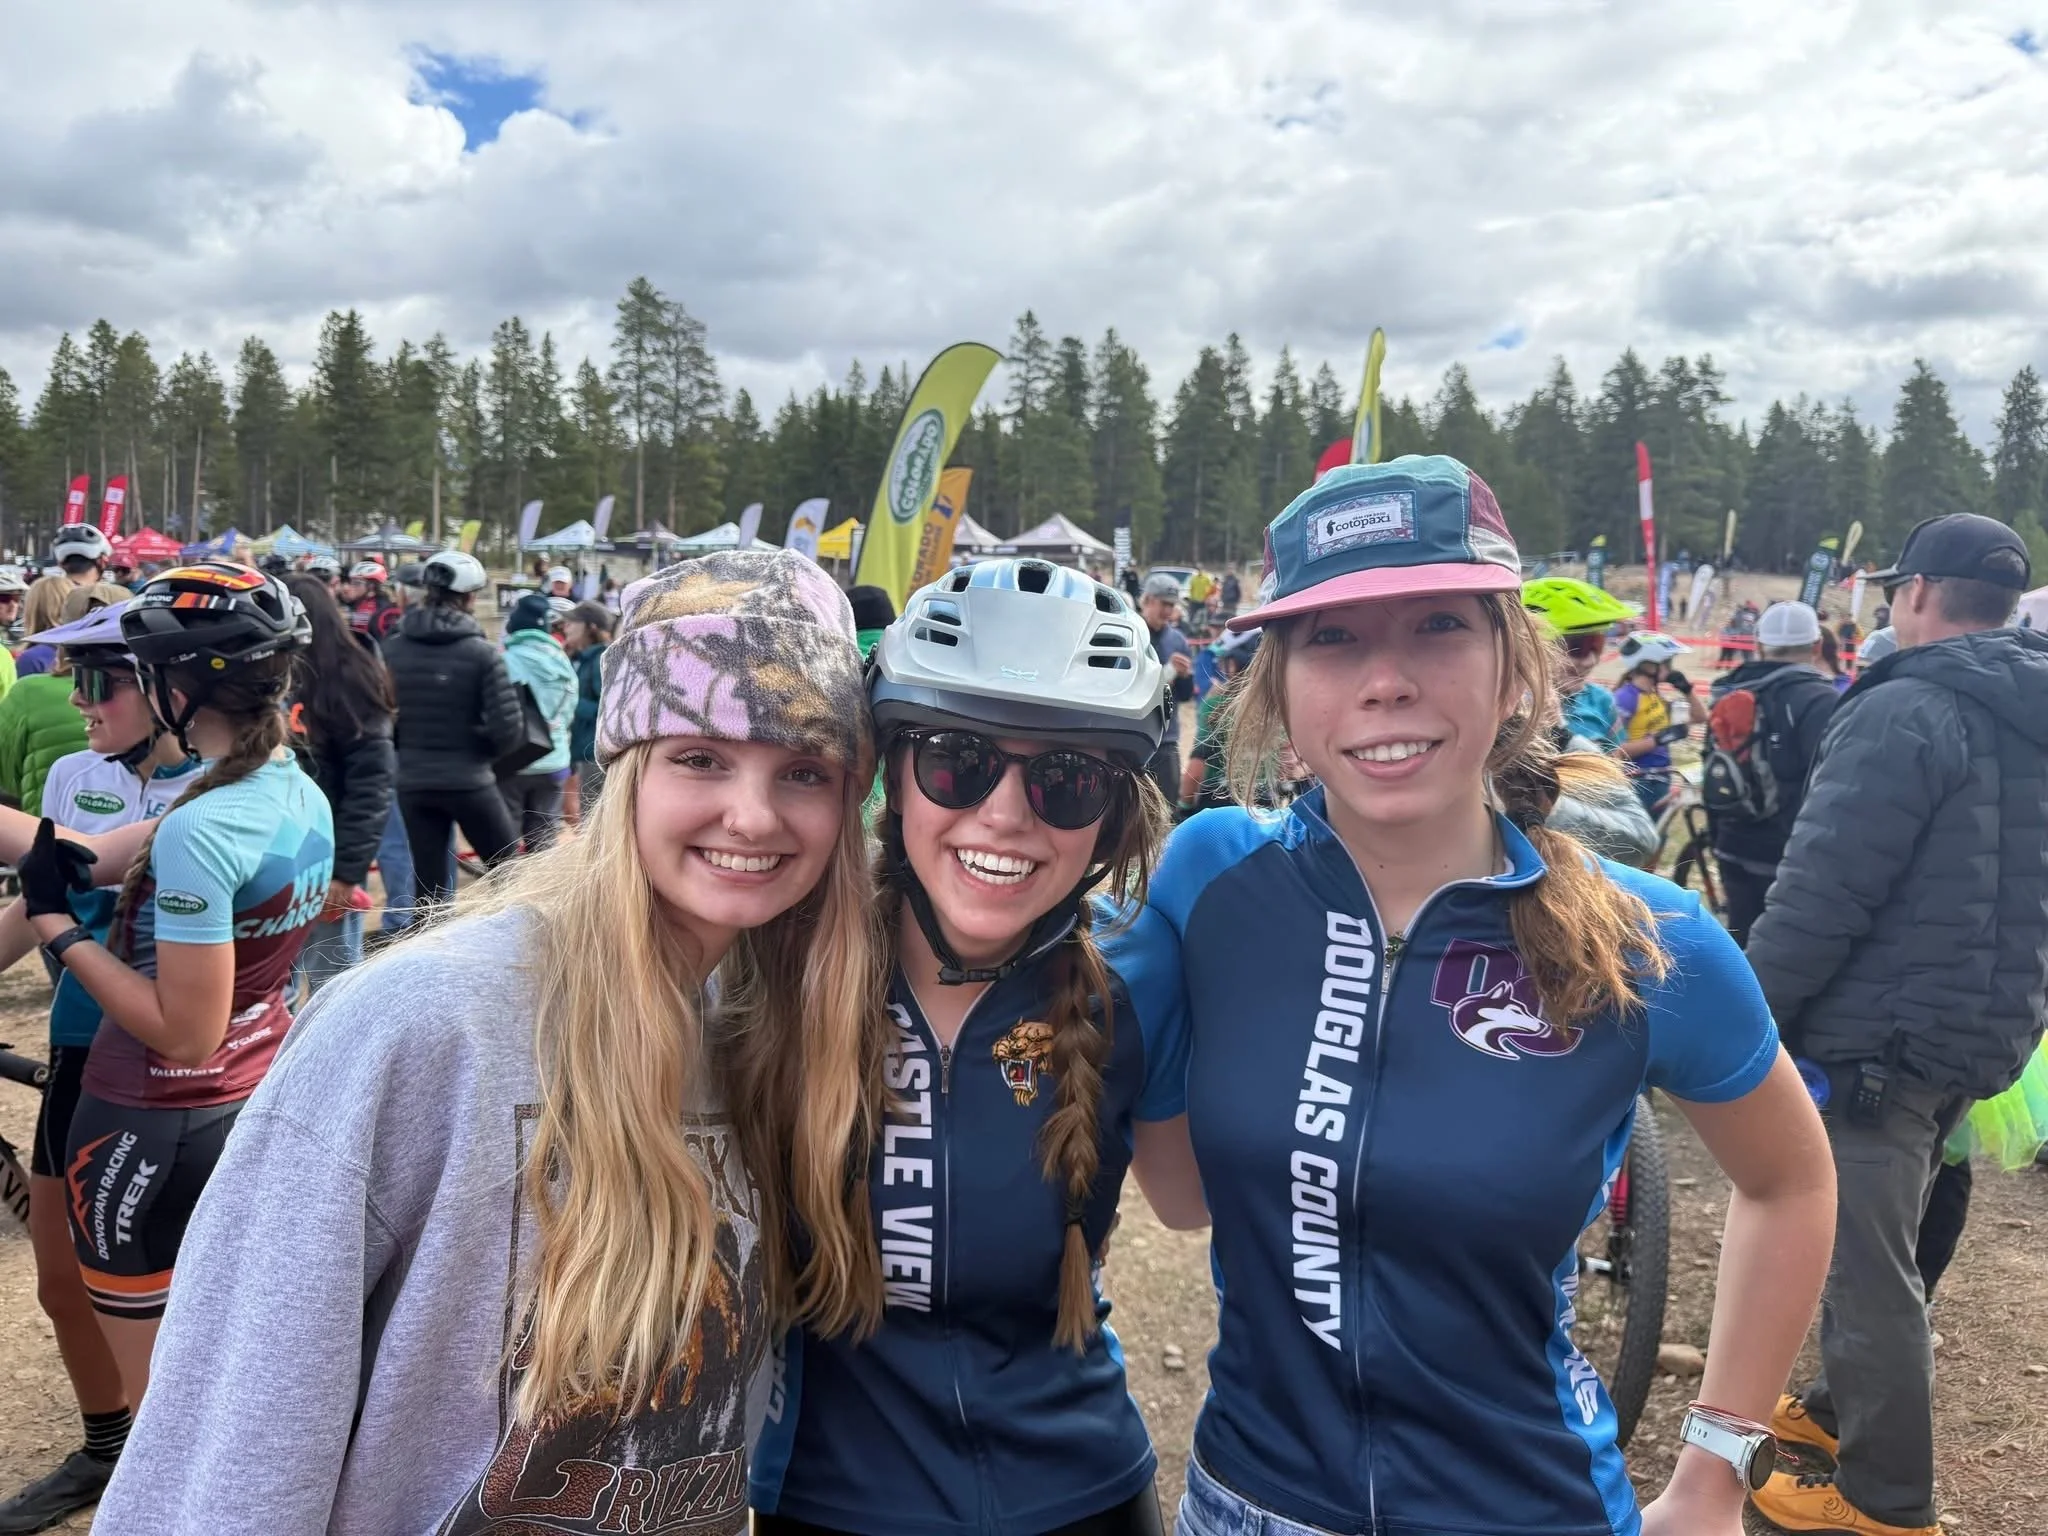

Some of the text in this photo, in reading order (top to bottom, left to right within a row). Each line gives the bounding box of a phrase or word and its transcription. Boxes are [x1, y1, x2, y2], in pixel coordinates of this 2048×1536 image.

[901, 418, 938, 511] COLORADO
[1335, 513, 1391, 532] cotopaxi
[149, 1066, 191, 1078] VALLEY
[1290, 911, 1374, 1352] DOUGLAS COUNTY
[94, 1130, 139, 1261] DONOVAN RACING
[115, 1158, 160, 1245] TREK
[882, 1204, 934, 1312] VIEW
